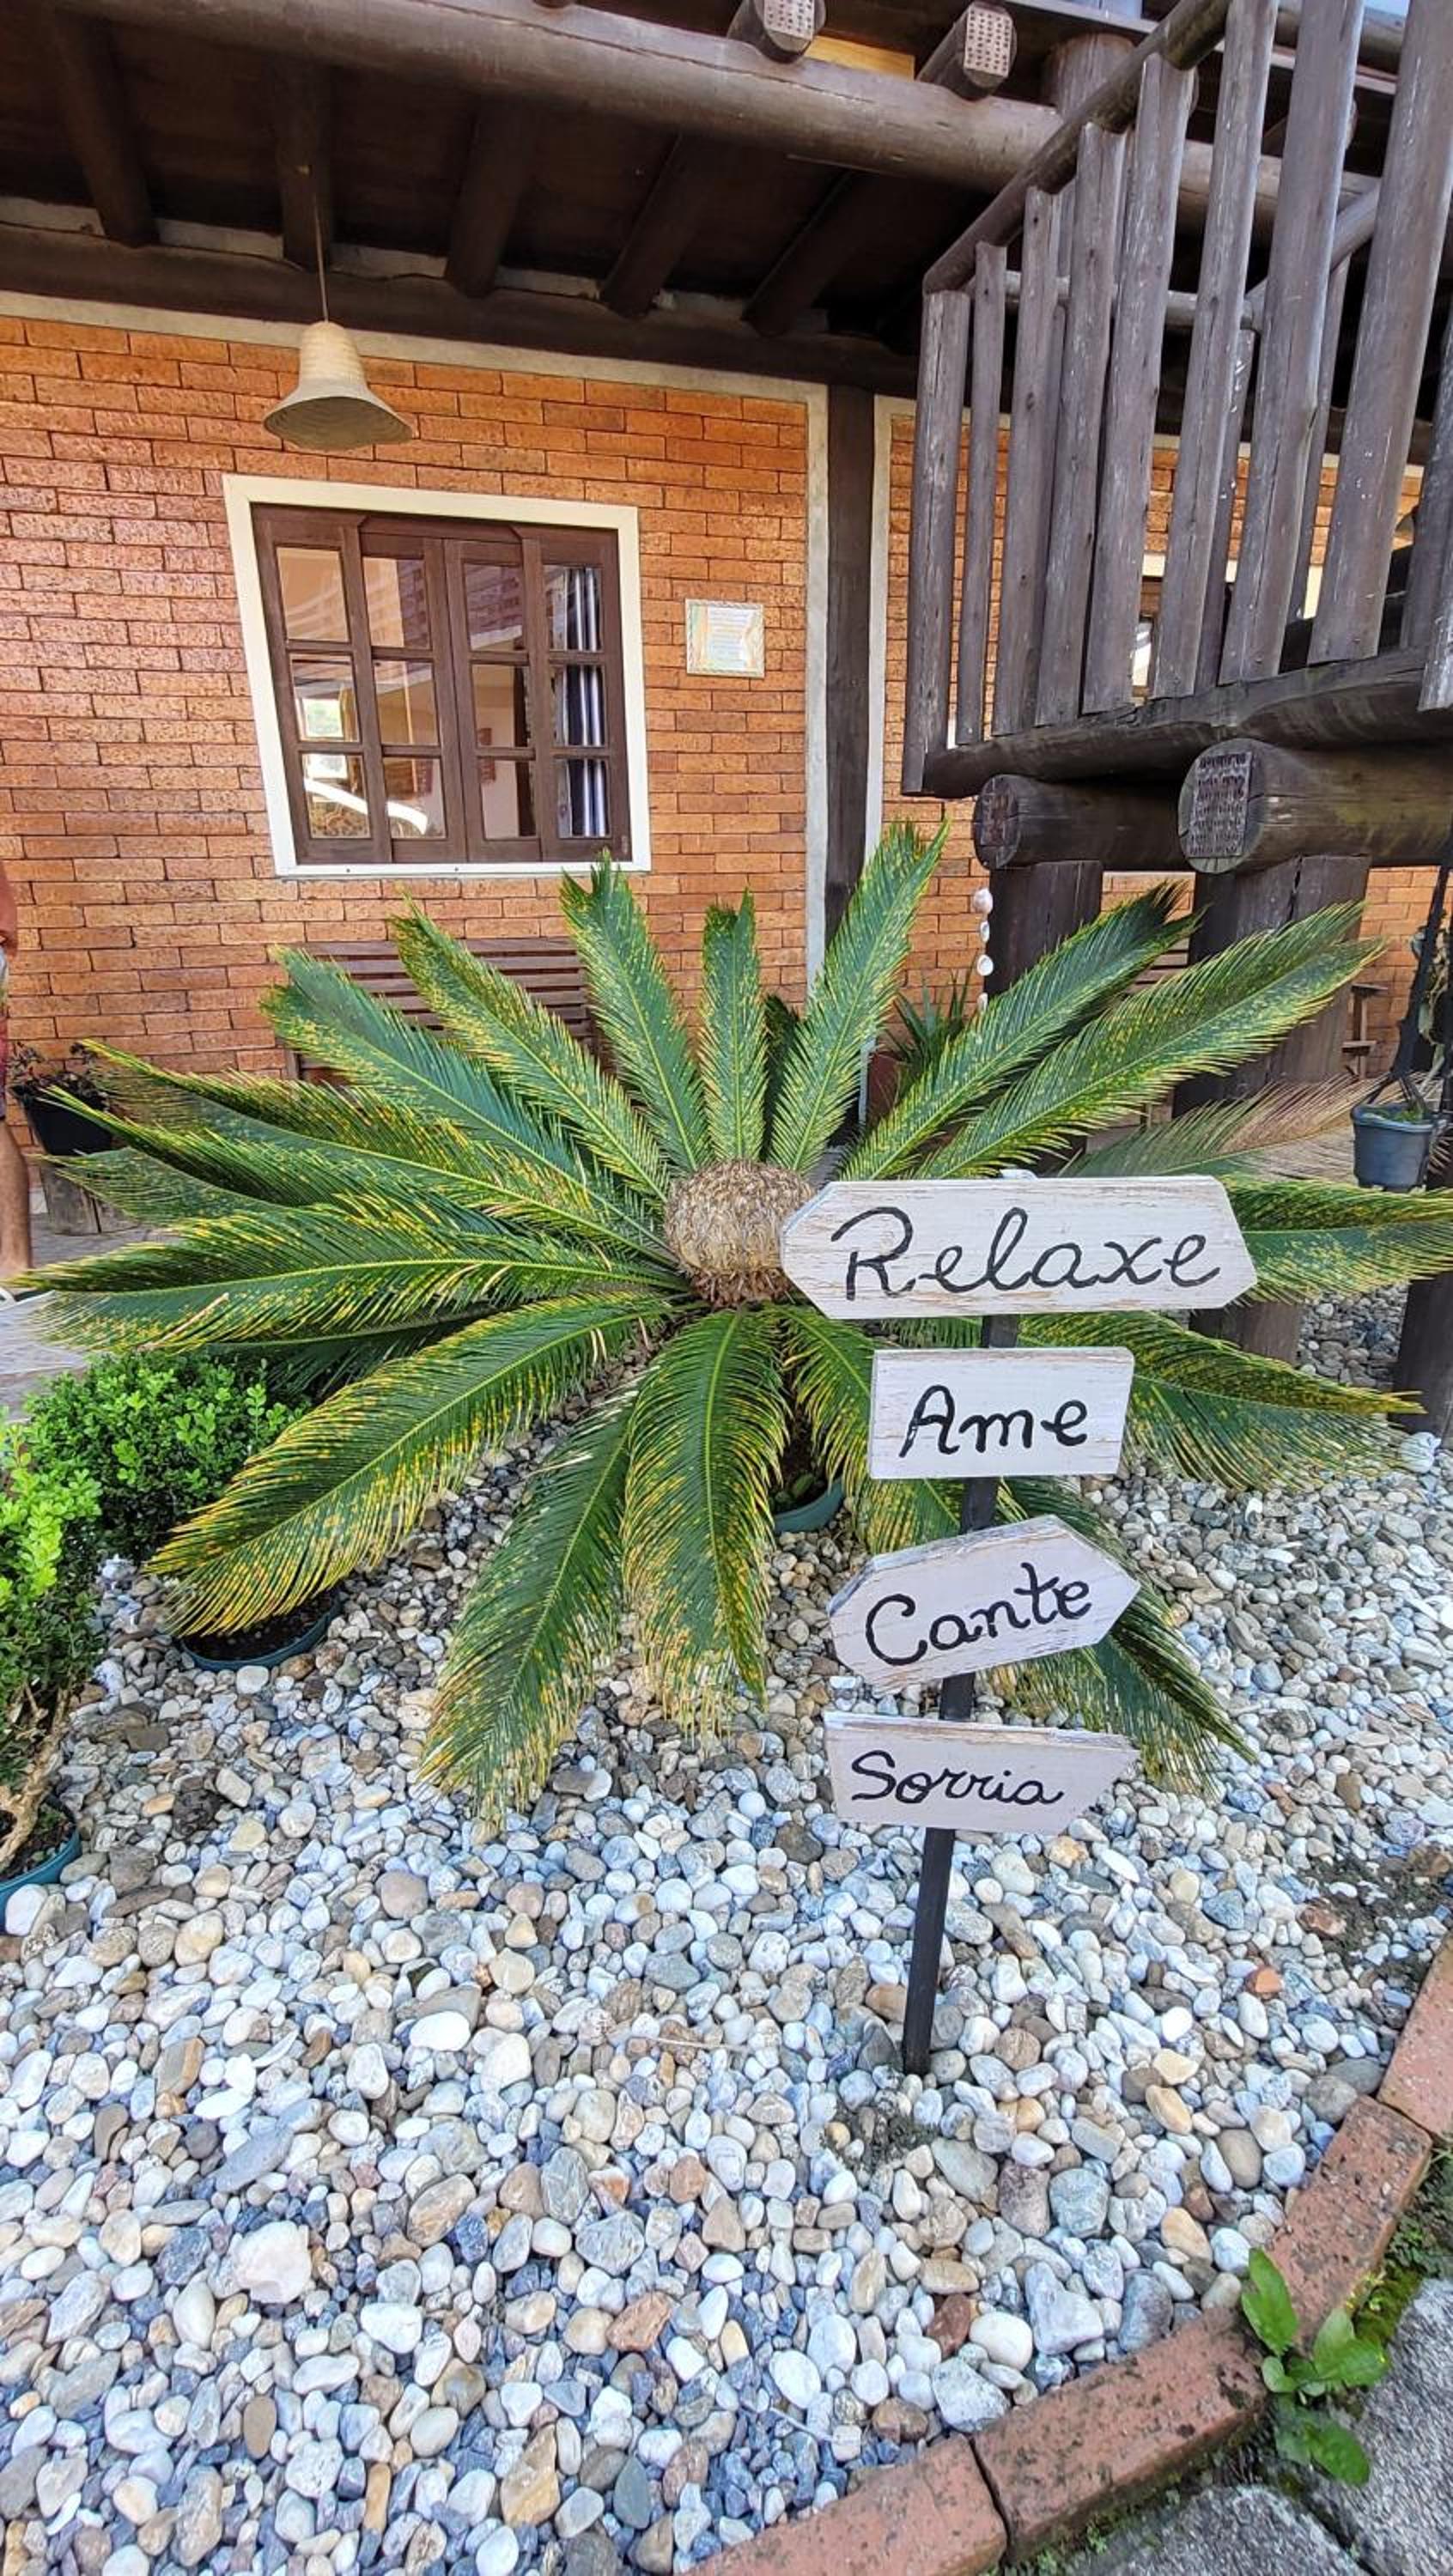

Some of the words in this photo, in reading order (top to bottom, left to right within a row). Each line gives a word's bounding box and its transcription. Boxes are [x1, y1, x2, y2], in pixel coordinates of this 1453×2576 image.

[830, 1206, 1220, 1300] Relaxe
[898, 1384, 1089, 1458] Ame
[865, 1561, 1092, 1666] Cante
[850, 1748, 1064, 1806] Sorria
